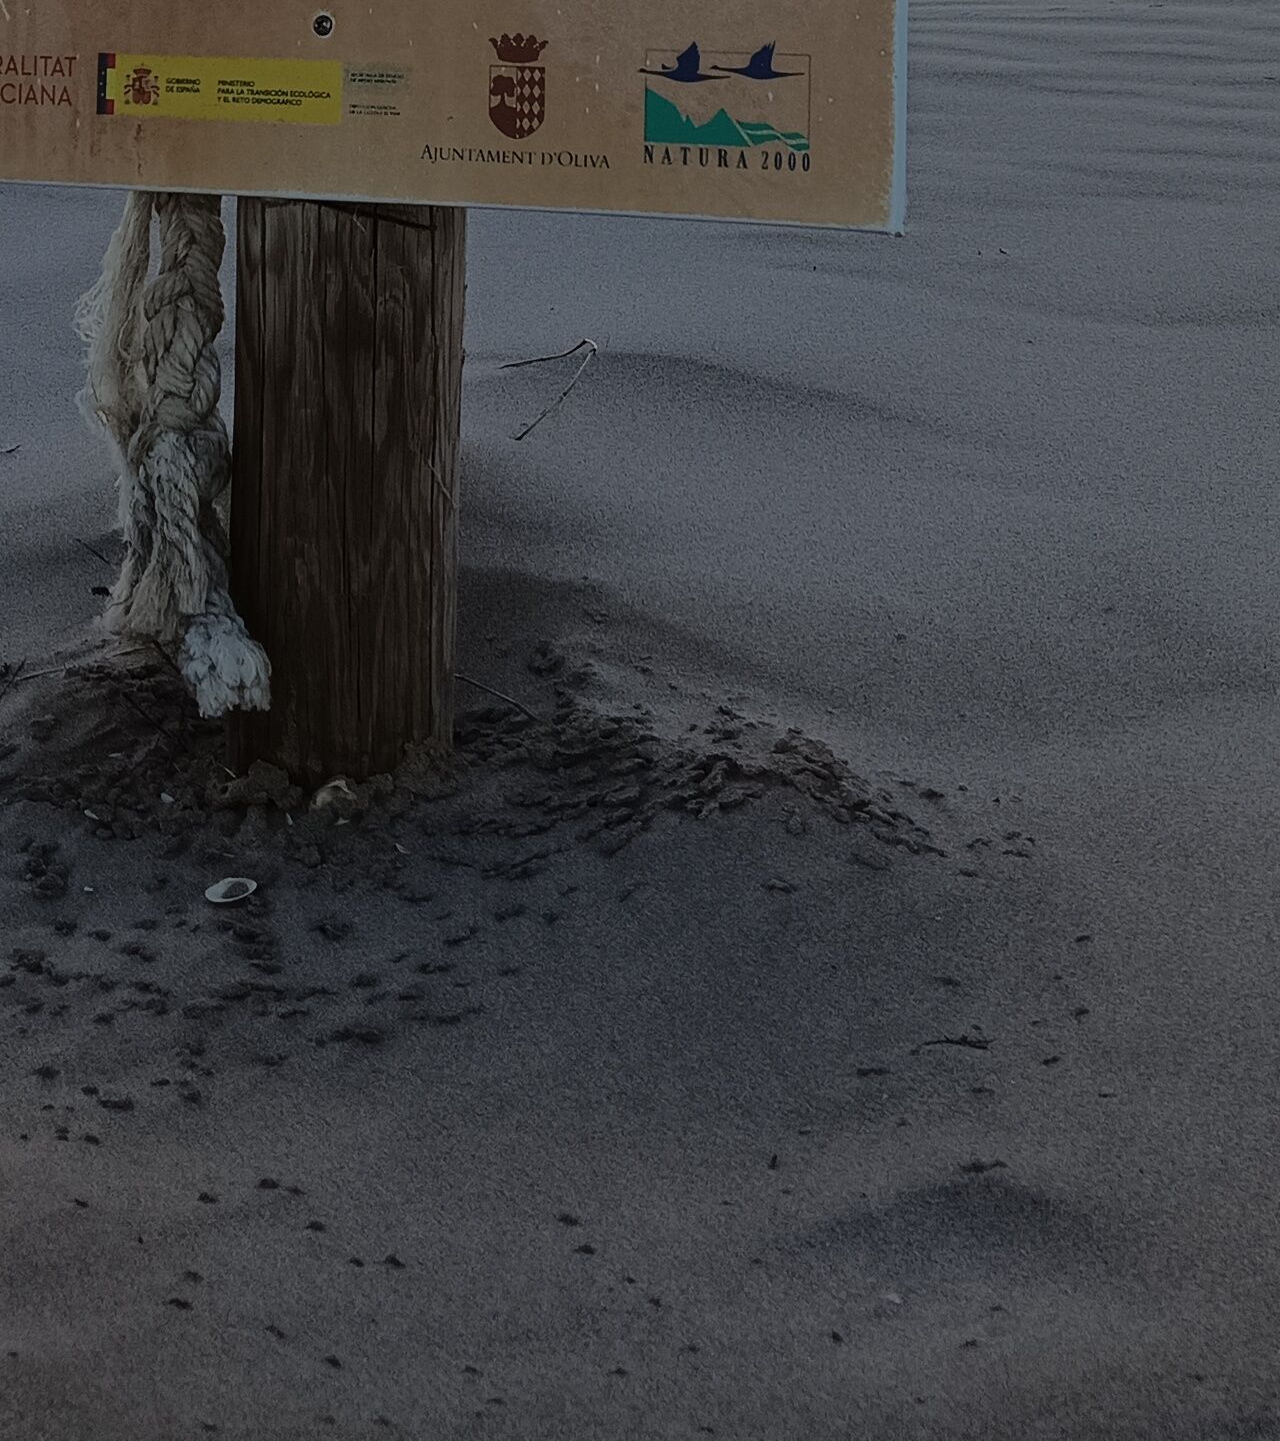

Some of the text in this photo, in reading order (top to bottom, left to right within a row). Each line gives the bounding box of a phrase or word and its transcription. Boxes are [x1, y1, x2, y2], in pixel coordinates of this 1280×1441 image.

[165, 85, 174, 93] DE
[216, 87, 235, 95] PARA
[236, 88, 244, 96] LA
[290, 90, 331, 99] ECOLÓGICA
[421, 144, 536, 165] AJUNTAMENT
[643, 144, 810, 172] NATURA 2000
